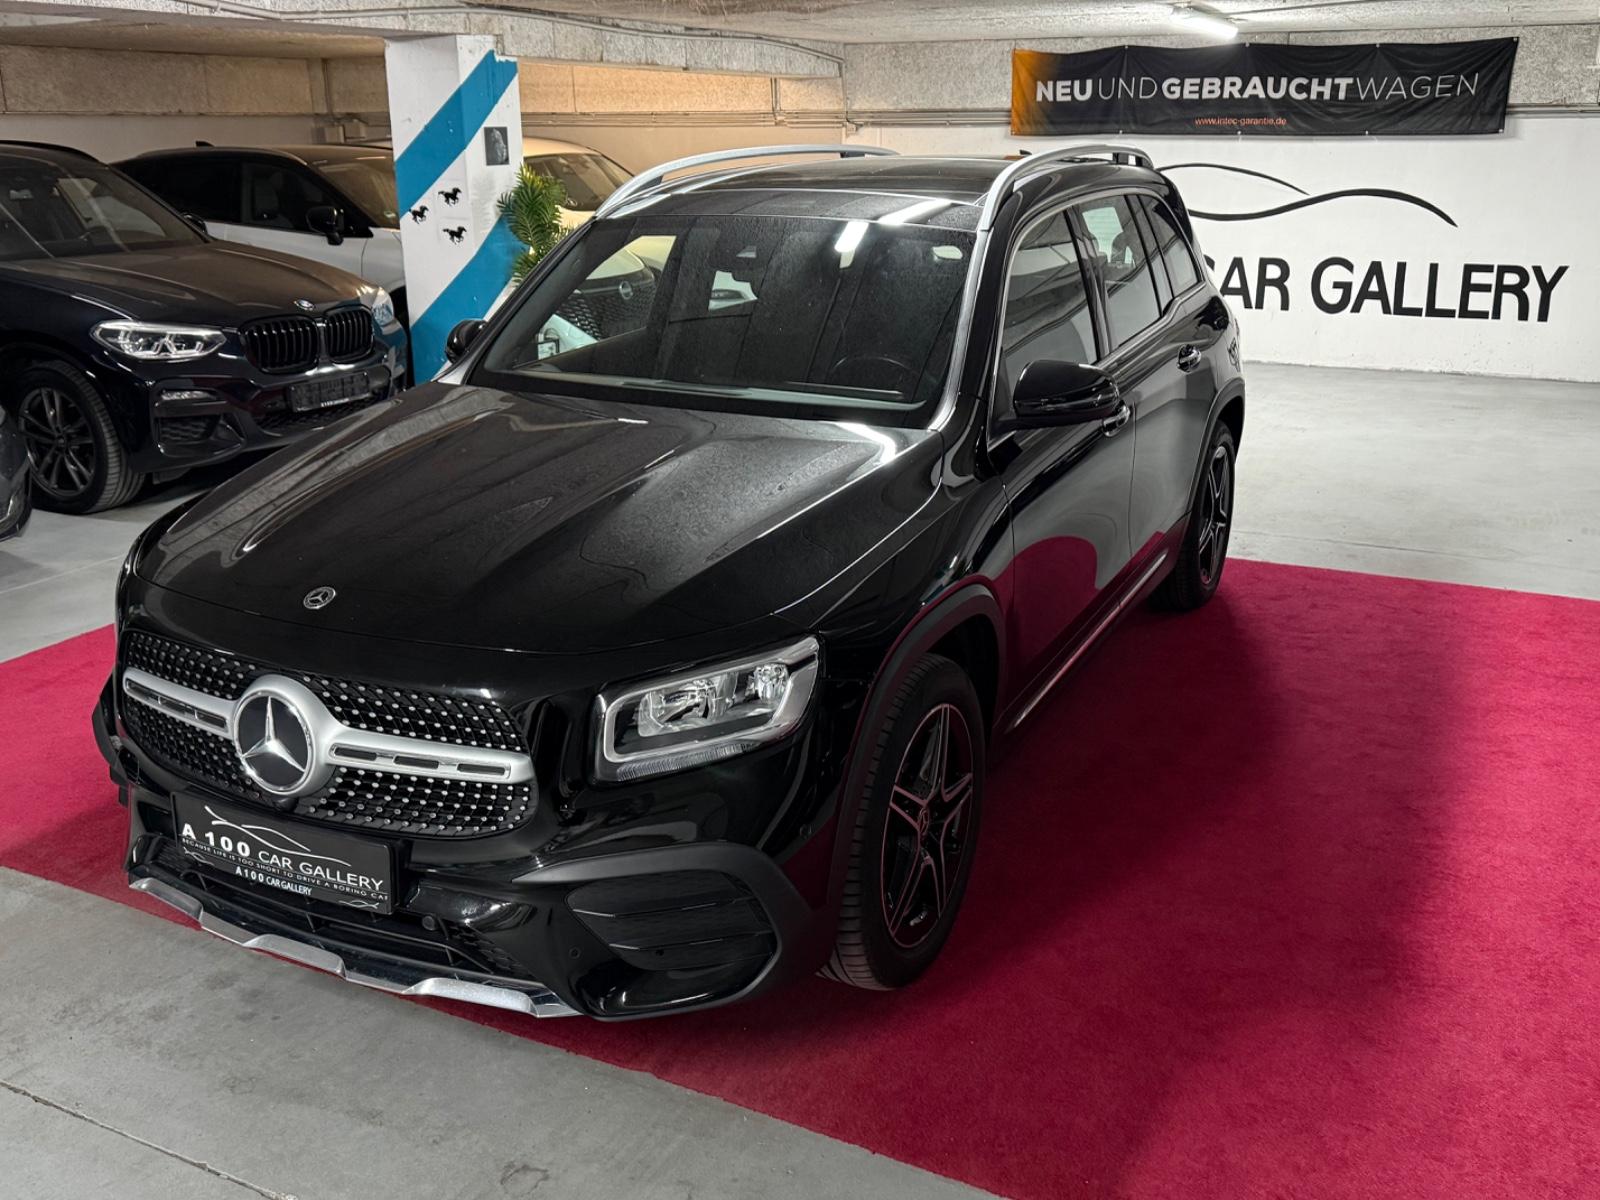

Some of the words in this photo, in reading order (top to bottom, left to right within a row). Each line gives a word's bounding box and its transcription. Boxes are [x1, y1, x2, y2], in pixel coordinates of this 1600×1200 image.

[1036, 78, 1093, 102] NEU
[1203, 254, 1290, 312] AR
[1310, 256, 1570, 323] GALLERY
[256, 863, 281, 875] SHORT
[283, 870, 294, 879] TO
[296, 873, 321, 886] DRIVE
[333, 884, 367, 896] BORING
[258, 850, 294, 871] CAR
[299, 862, 384, 892] GALLERY
